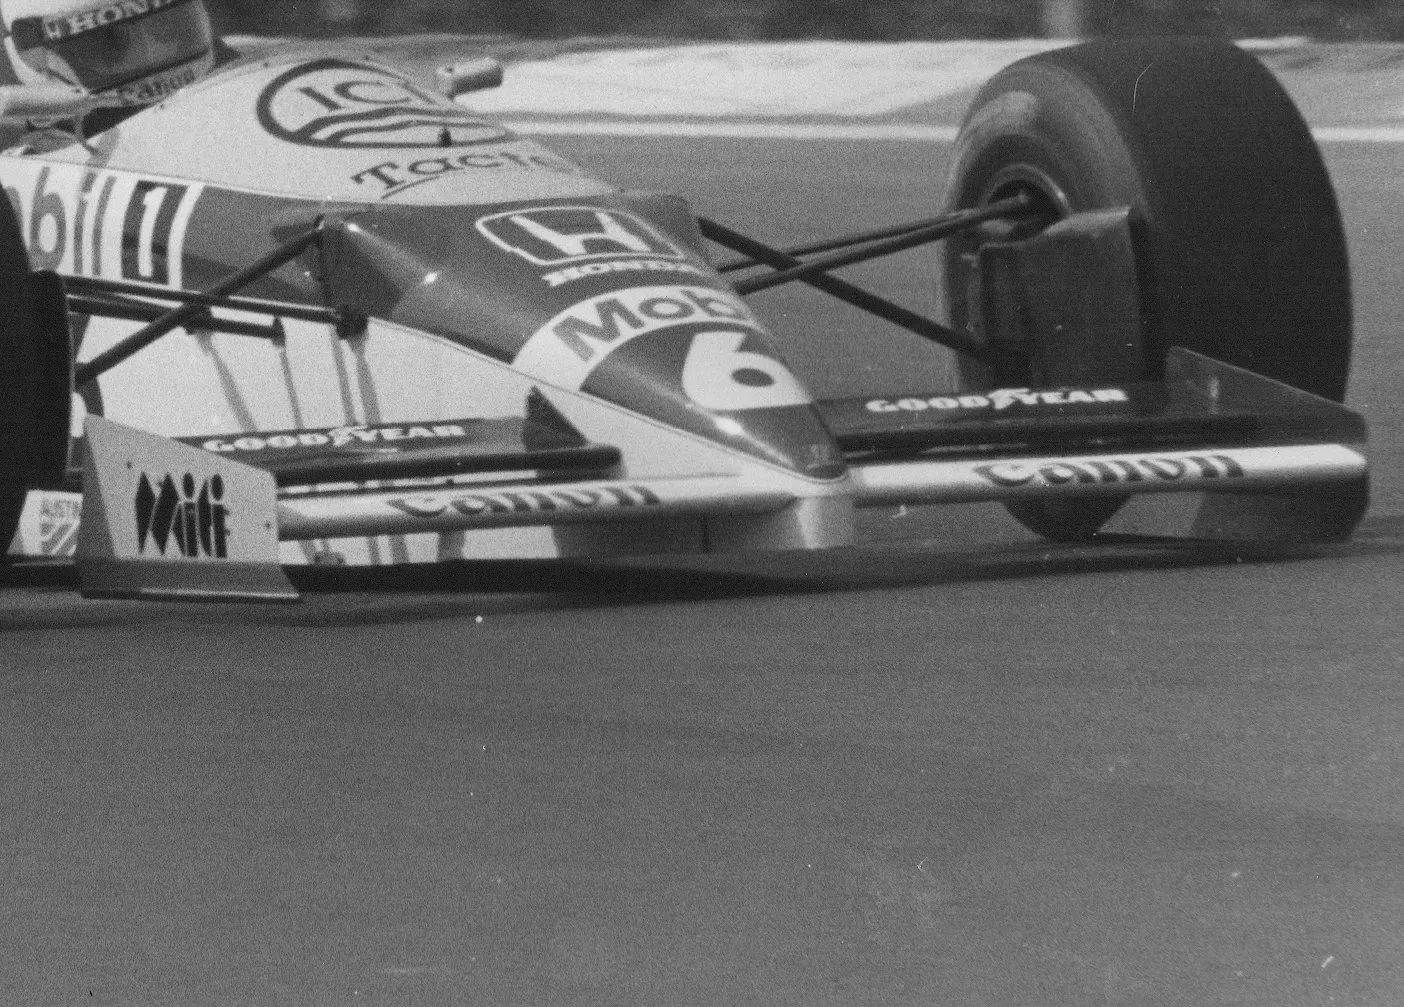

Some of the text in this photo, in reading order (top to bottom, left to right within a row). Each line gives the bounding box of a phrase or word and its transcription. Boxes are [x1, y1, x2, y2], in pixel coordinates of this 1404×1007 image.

[4, 165, 118, 277] bil
[552, 289, 744, 363] Mob
[681, 330, 813, 411] 6
[865, 387, 1129, 413] GOODYEAR
[202, 422, 467, 452] GOODYEAR
[972, 454, 1245, 486] Canon
[387, 482, 662, 518] Canon
